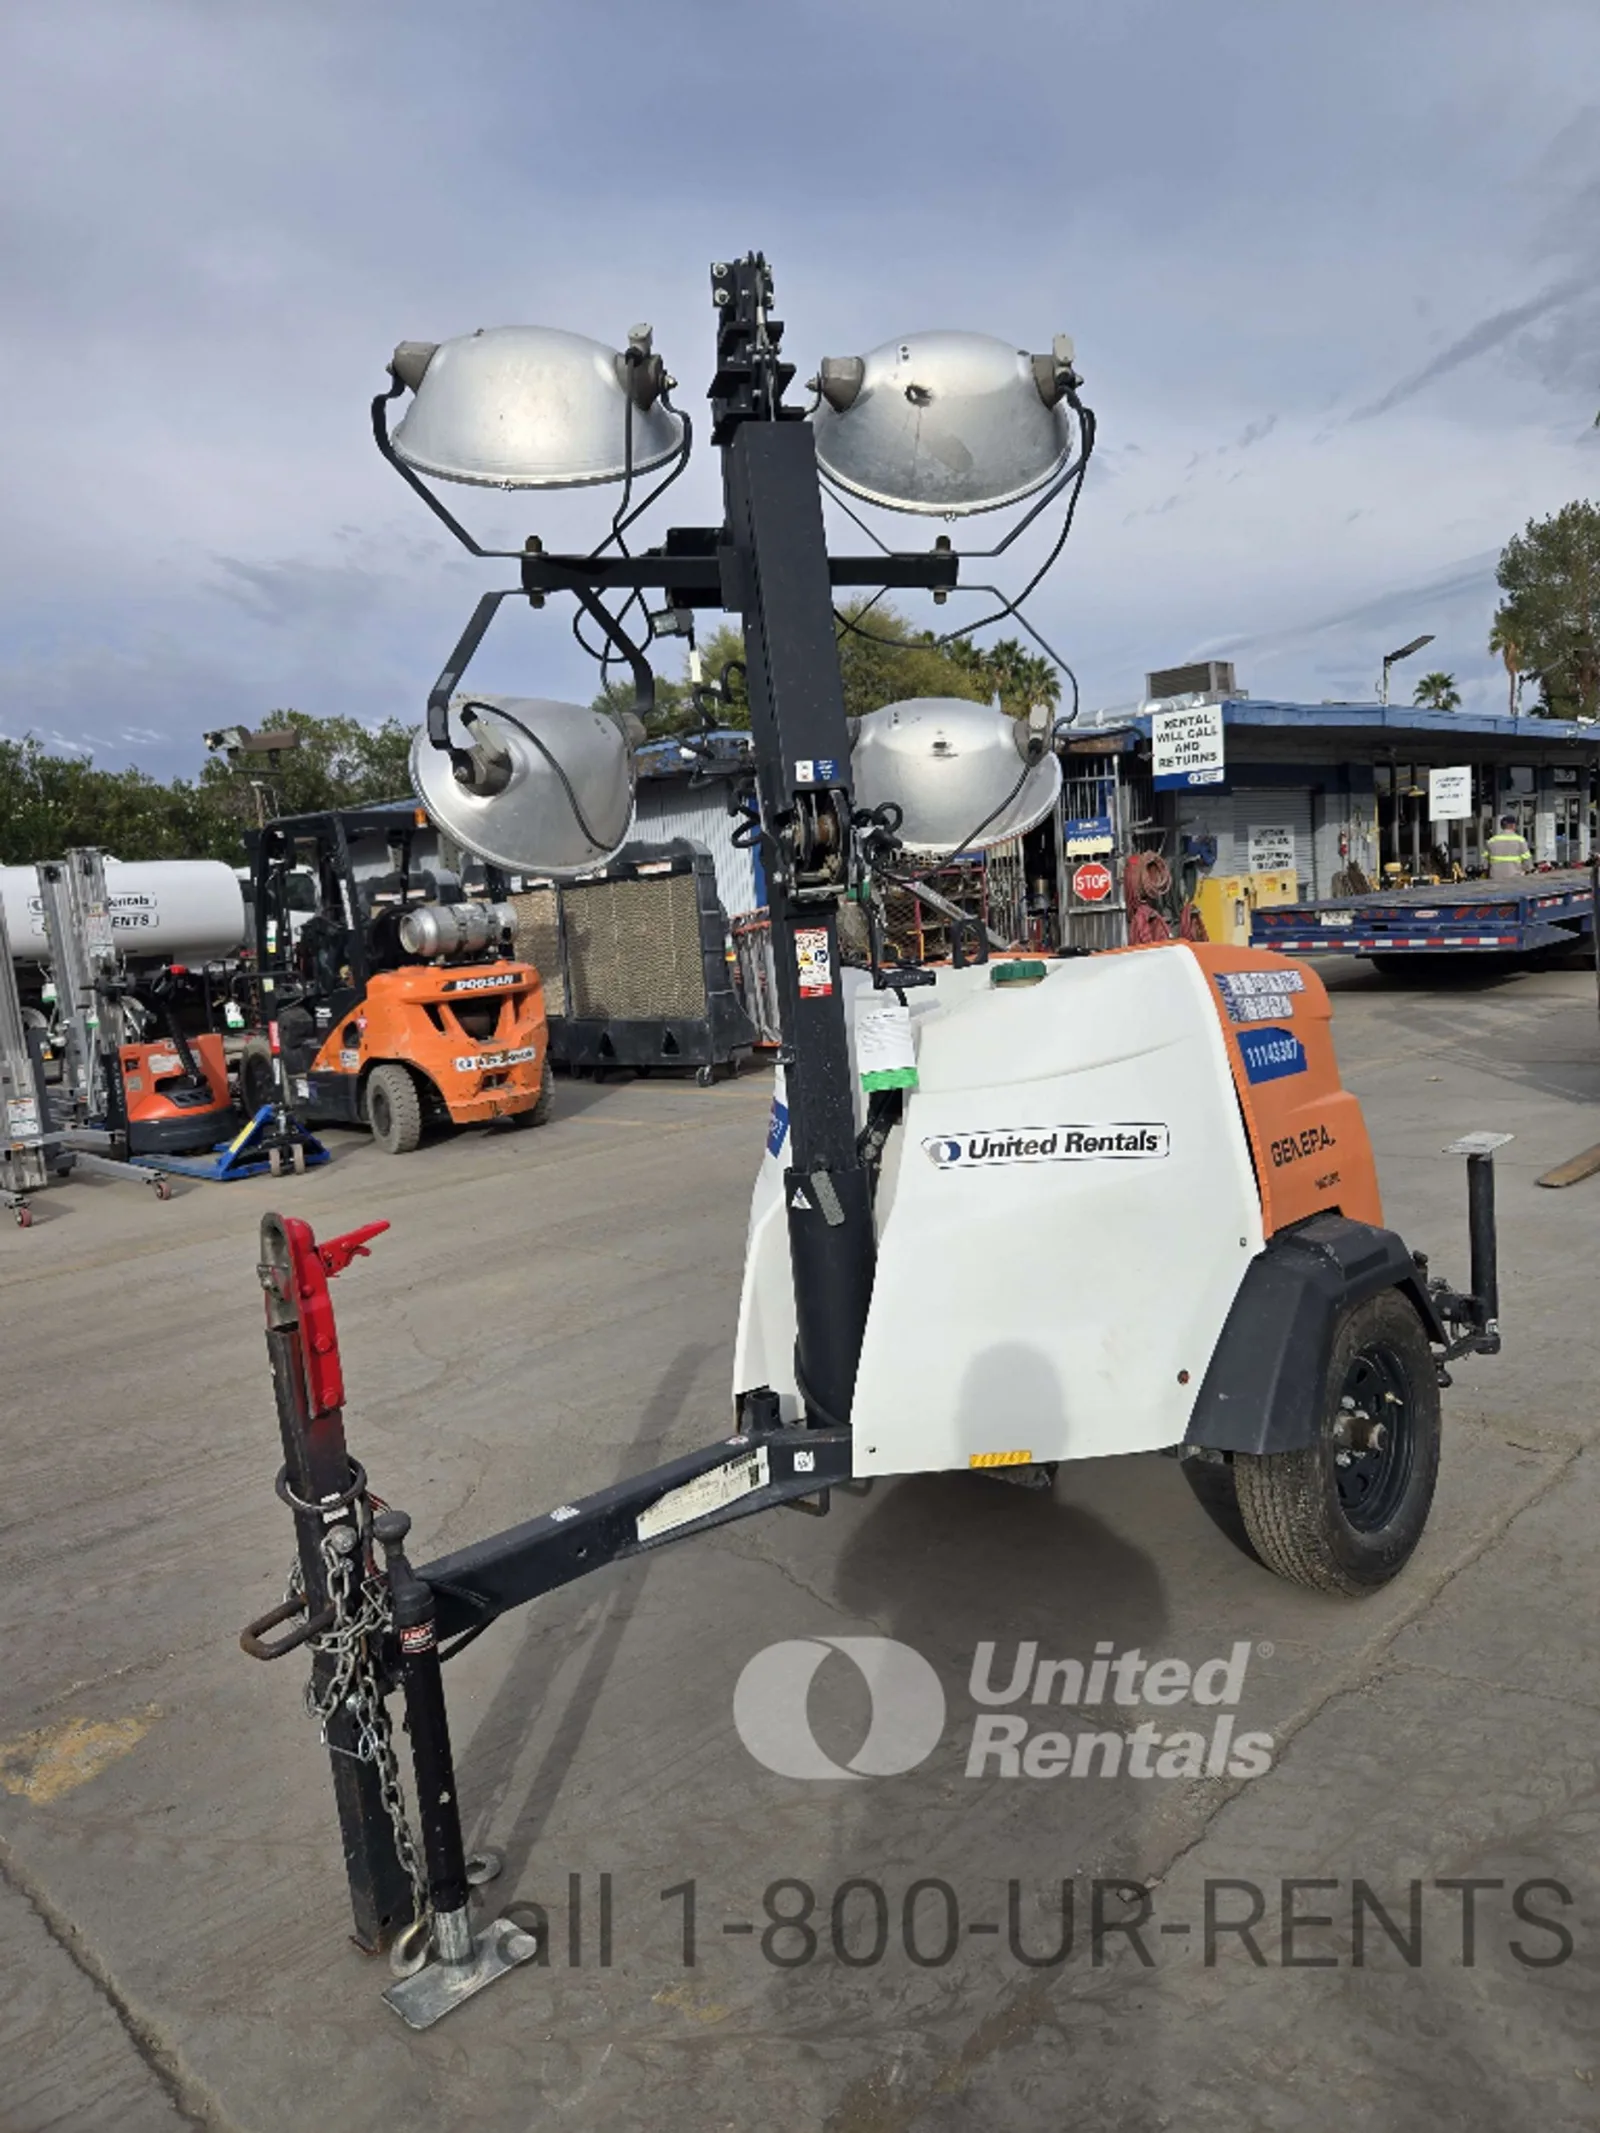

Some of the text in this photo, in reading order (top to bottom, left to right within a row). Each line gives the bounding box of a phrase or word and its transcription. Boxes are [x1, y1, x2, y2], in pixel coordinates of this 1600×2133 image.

[1164, 715, 1211, 729] RENTAL
[1157, 726, 1218, 743] WILL CALL
[1175, 742, 1200, 753] AND
[1159, 752, 1217, 767] RETURNS
[1076, 874, 1108, 891] STOP
[108, 895, 149, 907] entals
[111, 914, 149, 928] ENTS
[455, 974, 514, 991] DOOSAN
[968, 1129, 1158, 1159] United Rentals
[1270, 1124, 1336, 1168] GENERA
